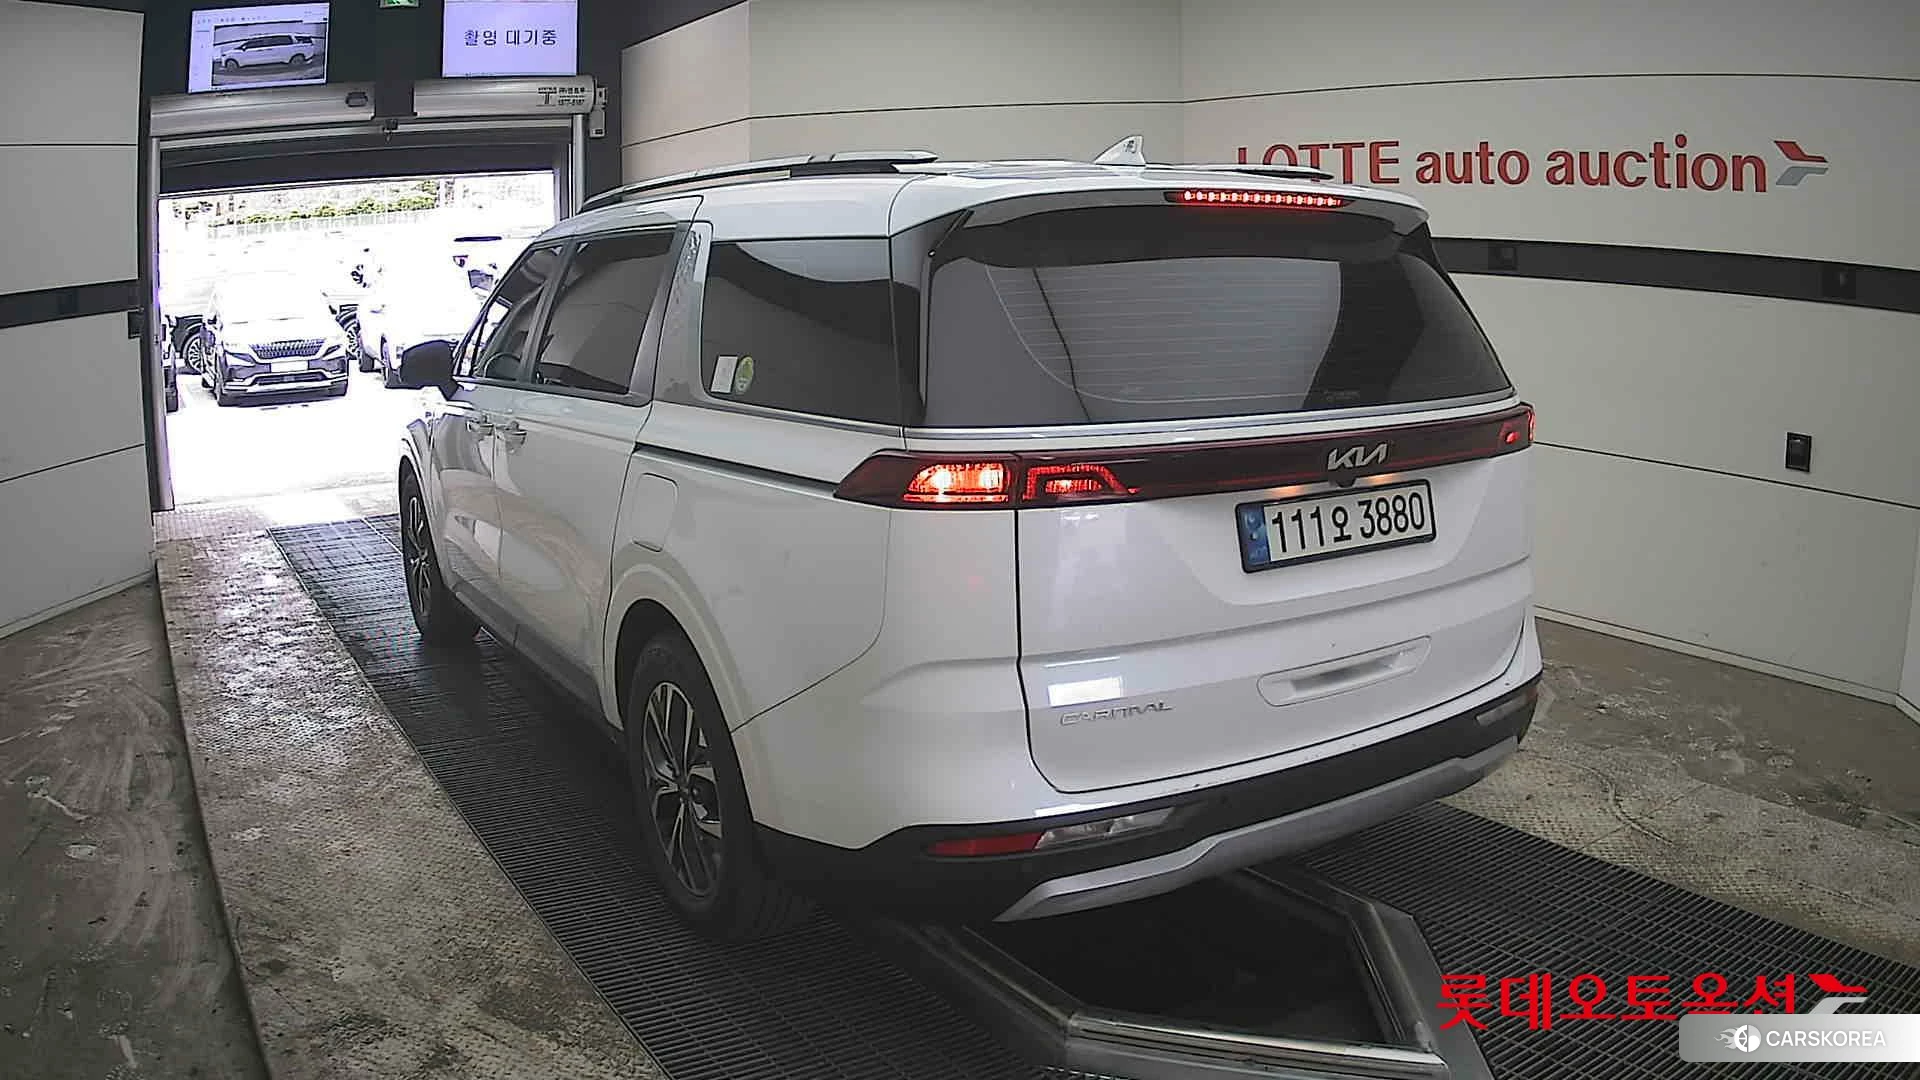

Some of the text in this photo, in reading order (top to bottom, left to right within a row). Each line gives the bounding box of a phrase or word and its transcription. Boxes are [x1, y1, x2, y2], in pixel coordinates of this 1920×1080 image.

[505, 29, 557, 46] 대기중
[1415, 141, 1530, 185] auto
[1545, 134, 1768, 193] auction
[1357, 491, 1426, 539] 3880
